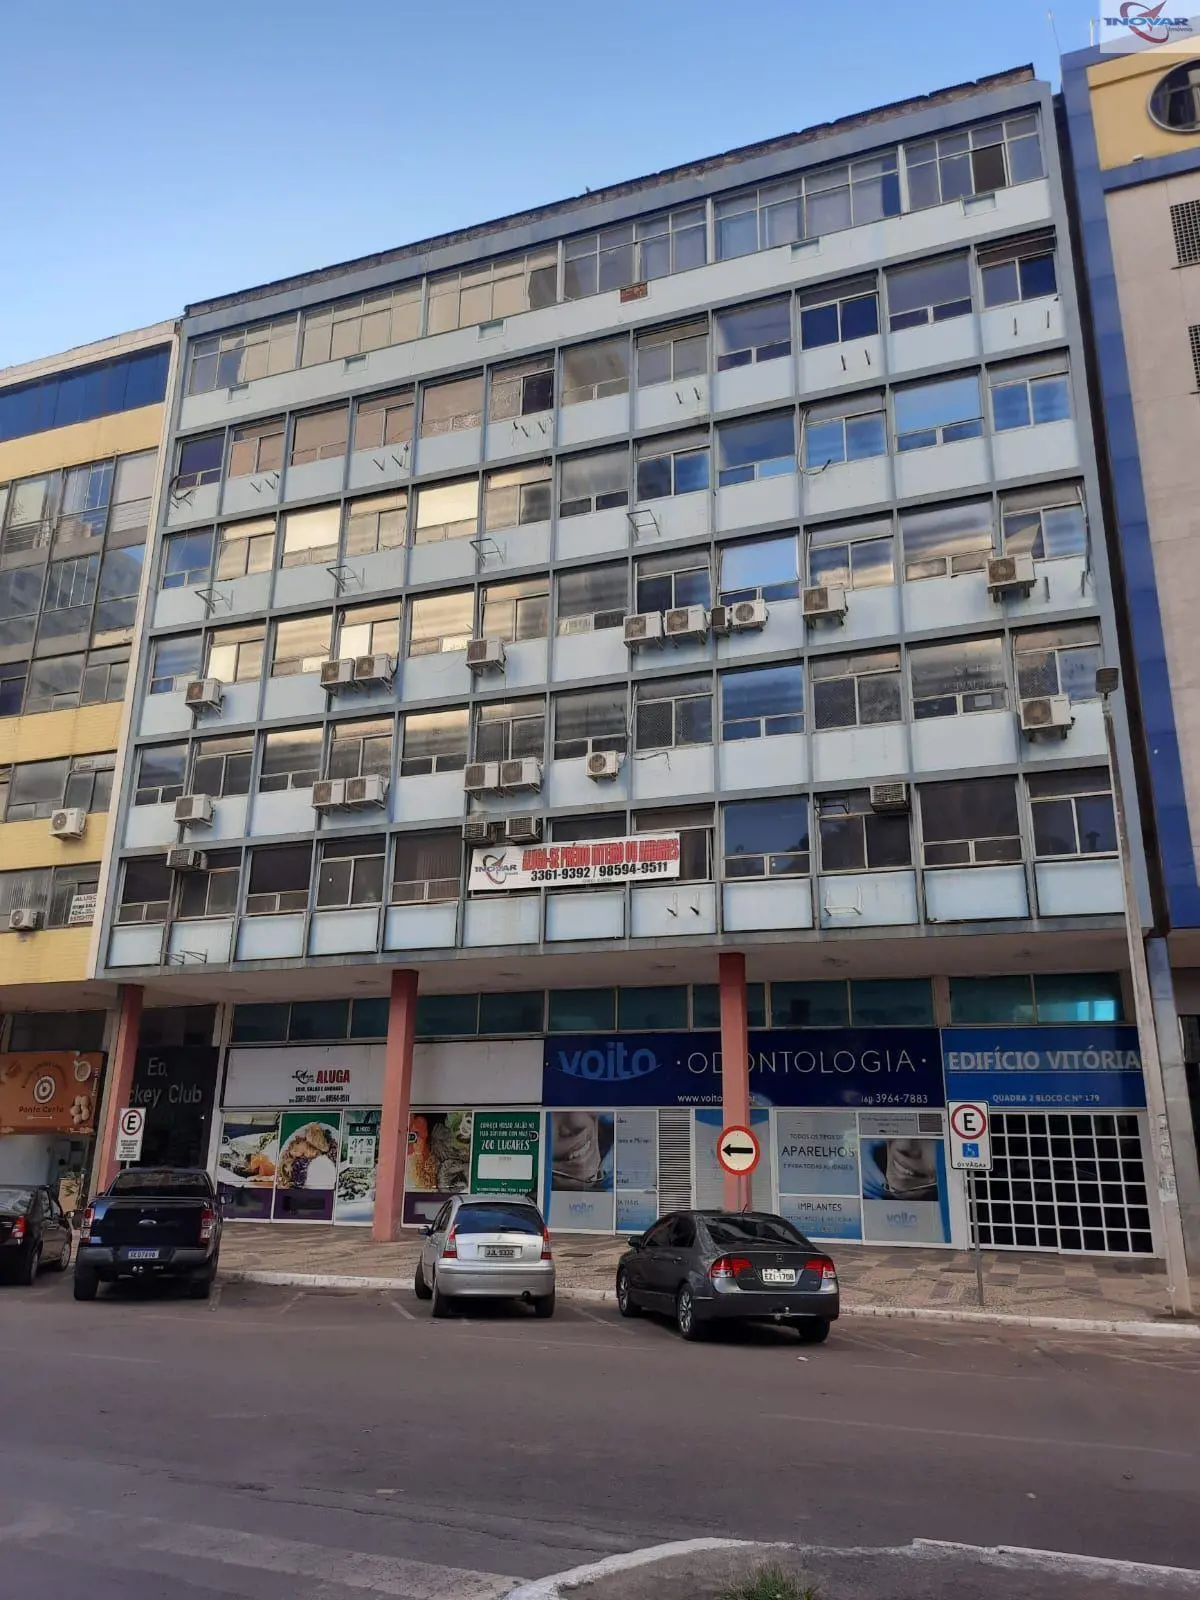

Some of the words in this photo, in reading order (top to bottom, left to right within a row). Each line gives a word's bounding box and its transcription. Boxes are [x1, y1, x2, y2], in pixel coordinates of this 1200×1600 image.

[531, 867, 590, 881] 3361-9392
[599, 862, 668, 877] 98594-9511
[558, 1041, 657, 1080] voito
[949, 1046, 1040, 1070] EDIFÍCIO
[1046, 1045, 1141, 1070] VITÓRIA
[316, 1069, 350, 1084] ALUGA
[168, 1081, 203, 1104] Club
[875, 1093, 928, 1104] 3964-7883
[992, 1094, 1027, 1103] QUADRA
[1035, 1094, 1063, 1102] BLOCO
[1064, 1094, 1071, 1102] C
[127, 1115, 137, 1130] E
[963, 1113, 976, 1132] E
[497, 1139, 530, 1151] LUGARES
[781, 1145, 855, 1158] APARELHOS
[797, 1202, 842, 1212] IMPLANTES
